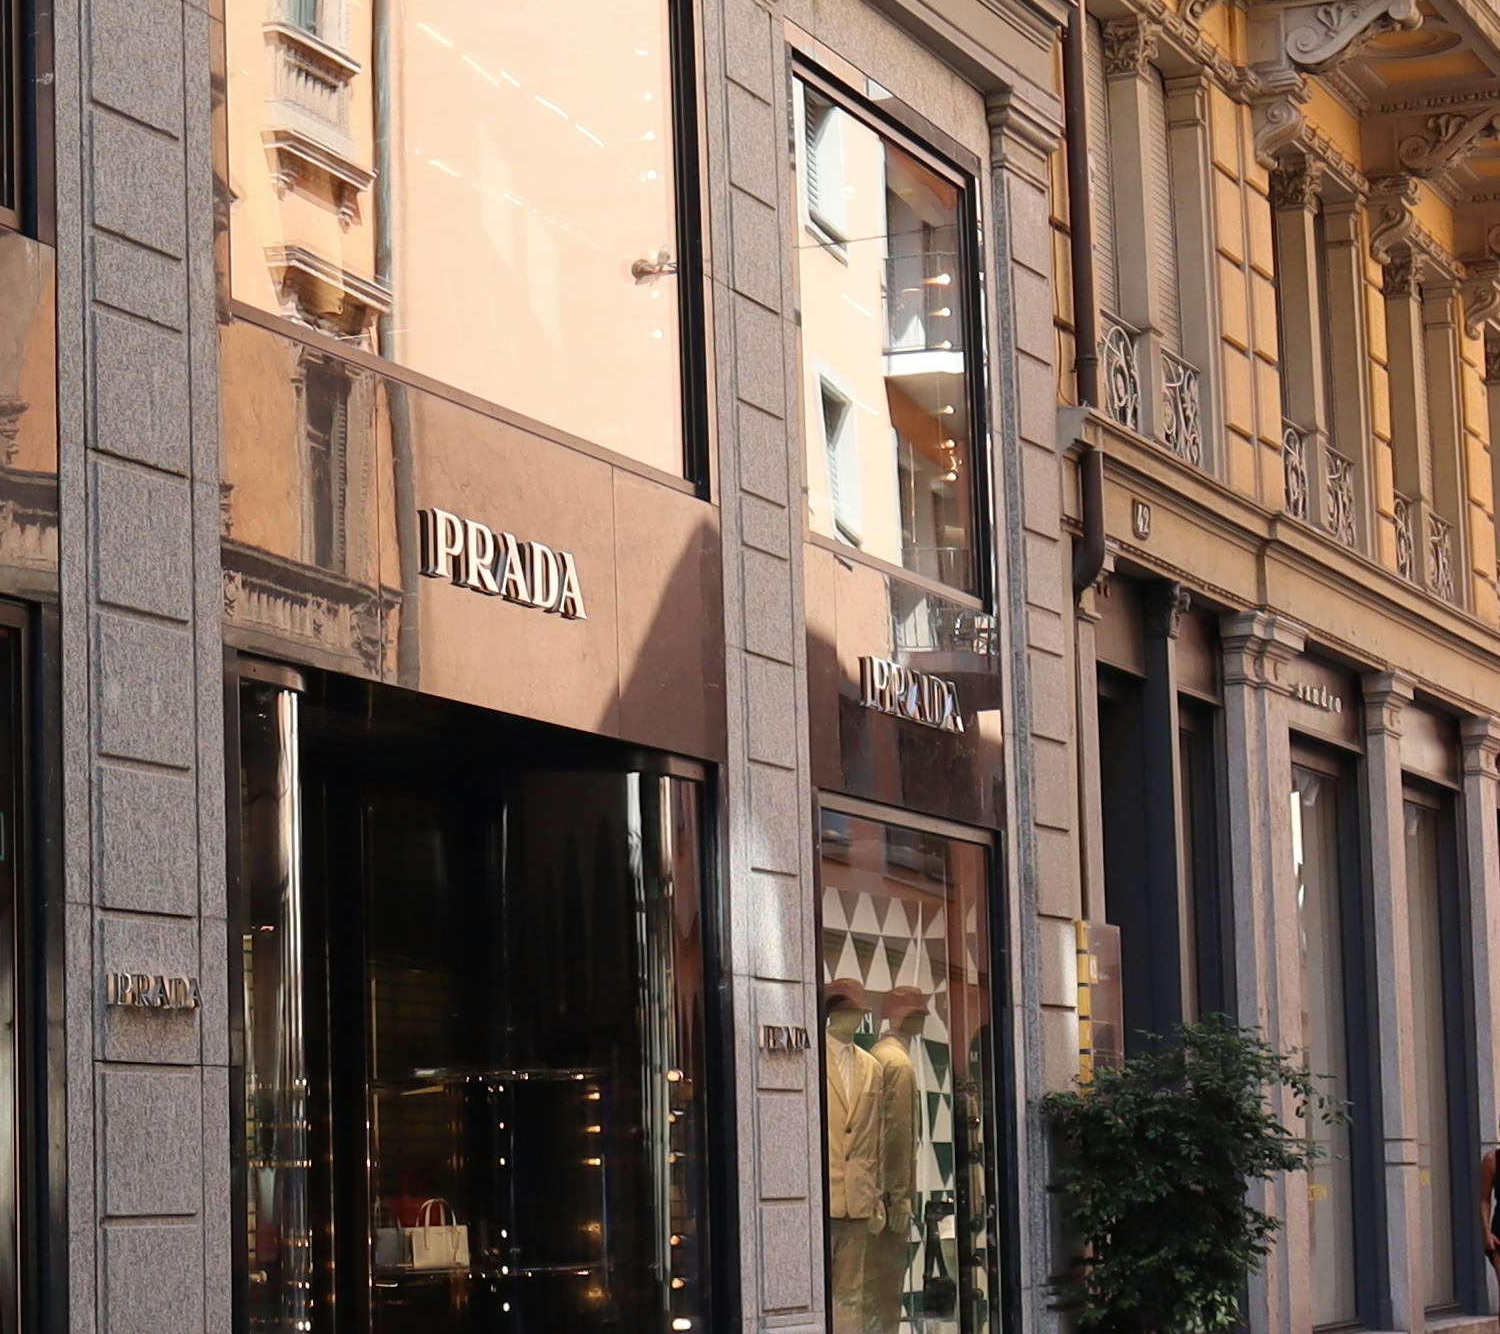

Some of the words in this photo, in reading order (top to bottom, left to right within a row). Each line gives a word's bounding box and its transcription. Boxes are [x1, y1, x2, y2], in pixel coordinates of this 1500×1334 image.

[1137, 503, 1150, 533] 42
[420, 507, 588, 619] PRADA
[858, 655, 965, 733] PRADA
[106, 972, 204, 1009] PRADA
